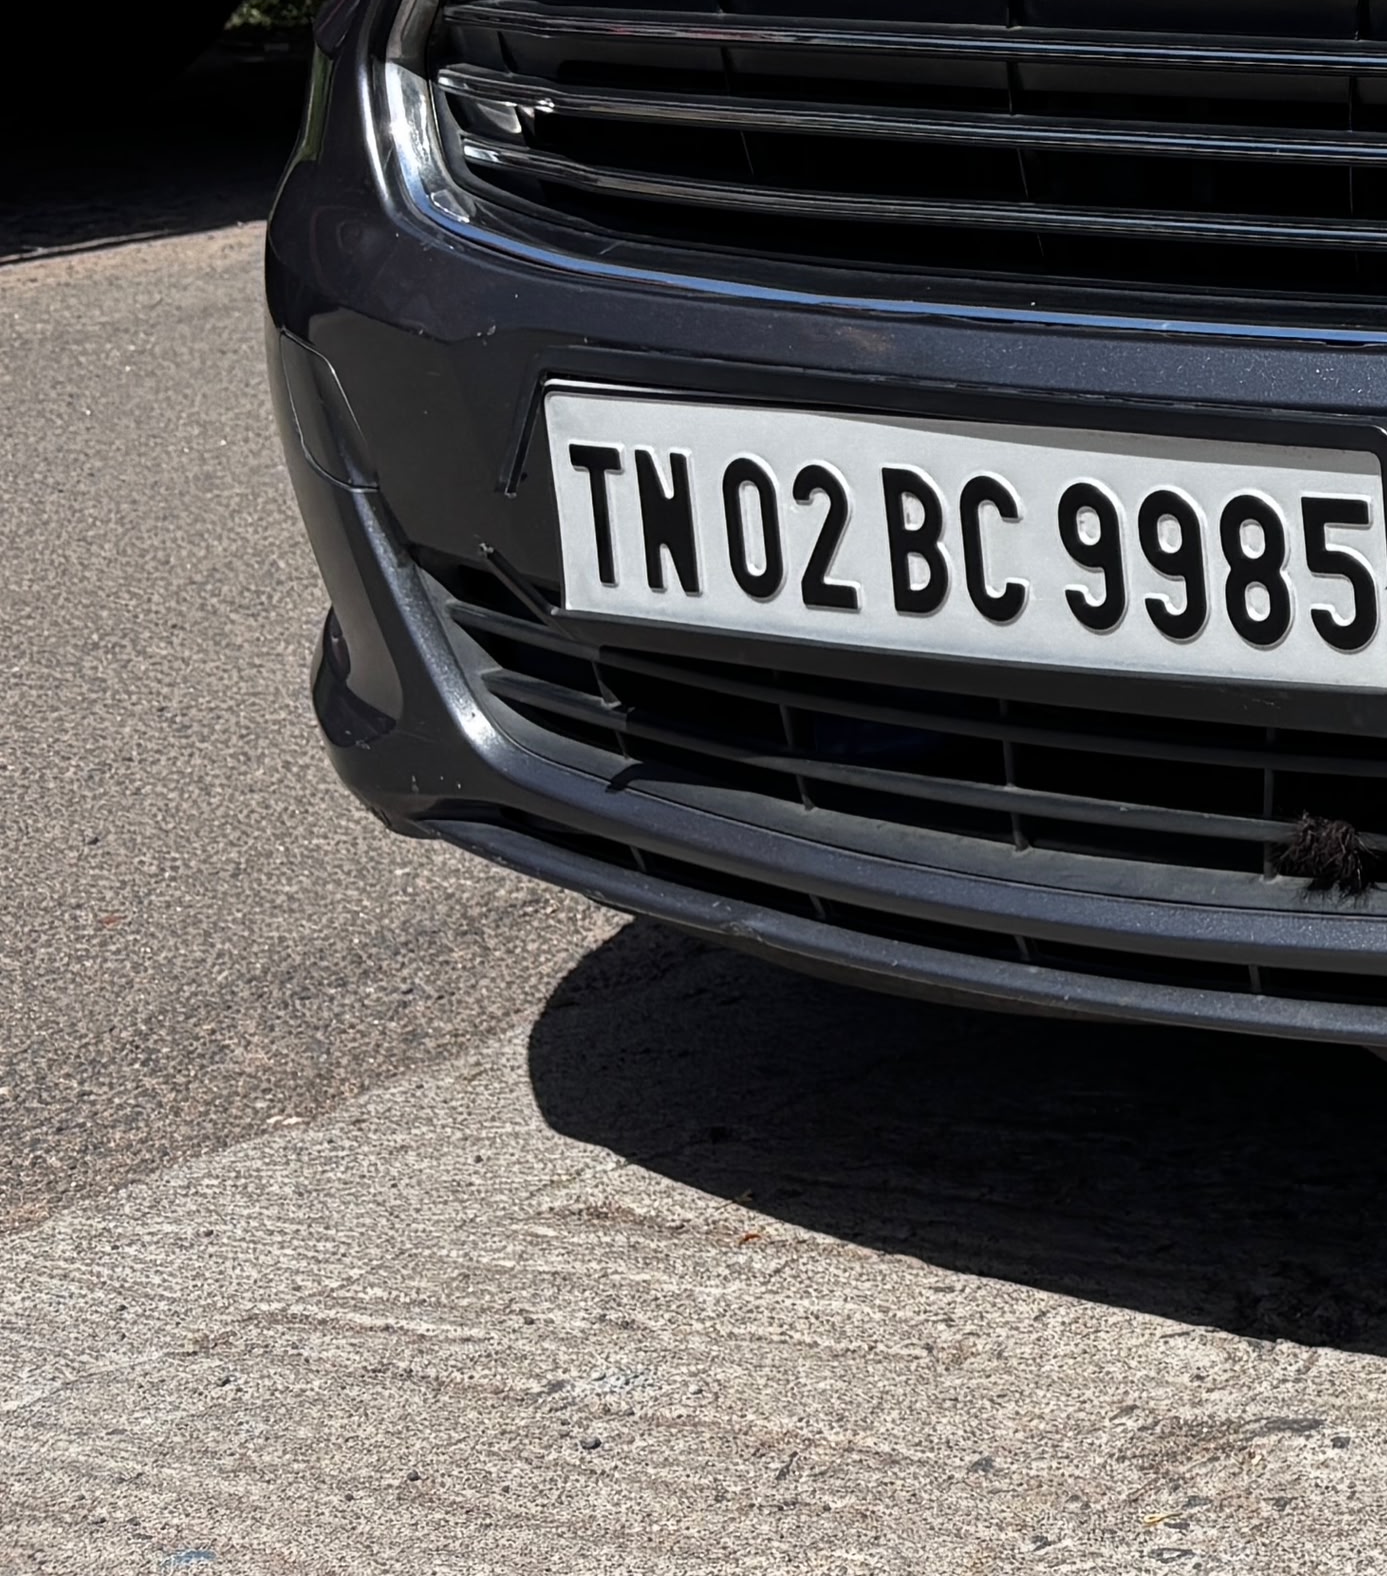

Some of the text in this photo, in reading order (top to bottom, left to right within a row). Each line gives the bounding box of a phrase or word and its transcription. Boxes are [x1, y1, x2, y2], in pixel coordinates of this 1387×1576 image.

[569, 442, 1379, 651] TN 02 BC 9985
